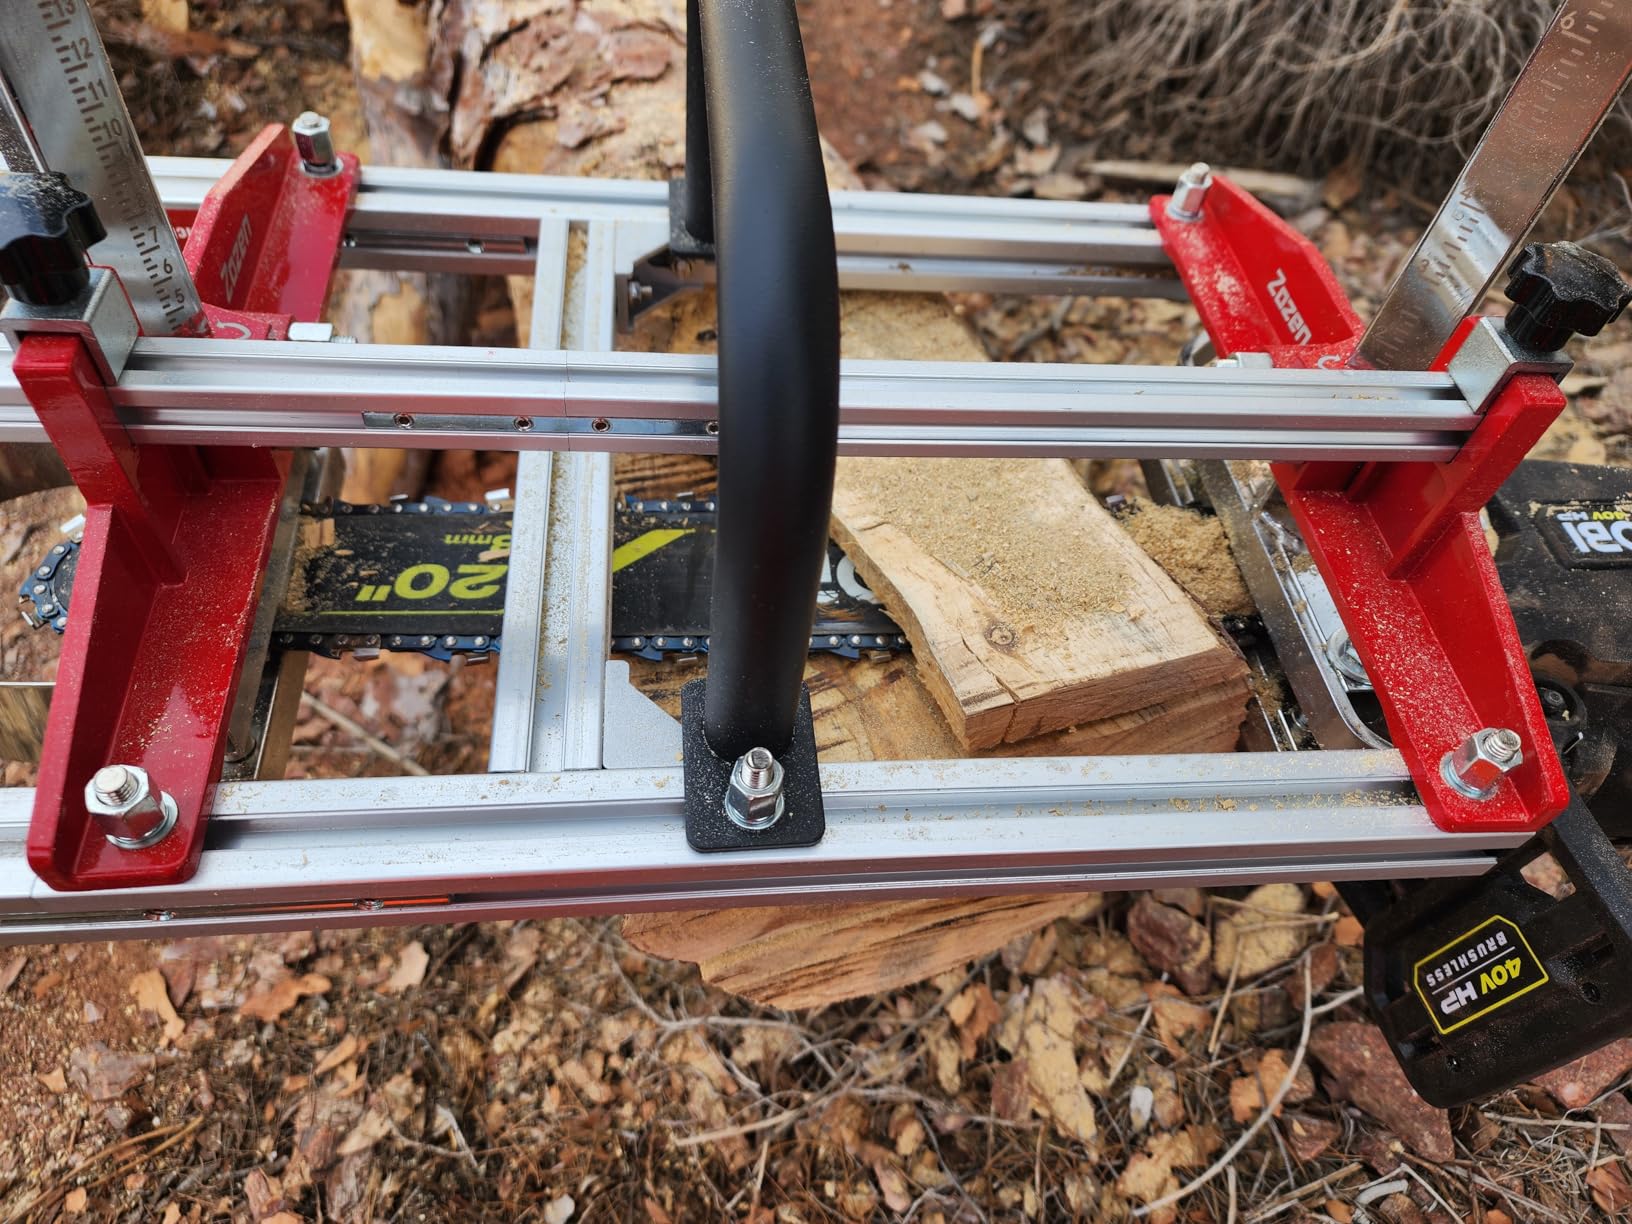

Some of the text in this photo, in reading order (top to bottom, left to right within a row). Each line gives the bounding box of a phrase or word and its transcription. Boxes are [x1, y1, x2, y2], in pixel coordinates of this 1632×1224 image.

[70, 36, 94, 61] 12
[88, 77, 109, 101] 11
[102, 118, 123, 140] 10
[147, 226, 158, 243] 7
[163, 258, 173, 275] 6
[220, 213, 253, 304] Zozen
[174, 287, 185, 304] 5
[1266, 267, 1313, 346] Zozen
[1556, 510, 1590, 521] HP
[354, 562, 510, 602] 20"
[1425, 930, 1509, 987] BRUSHLESS
[1440, 957, 1522, 1015] 40V HP
